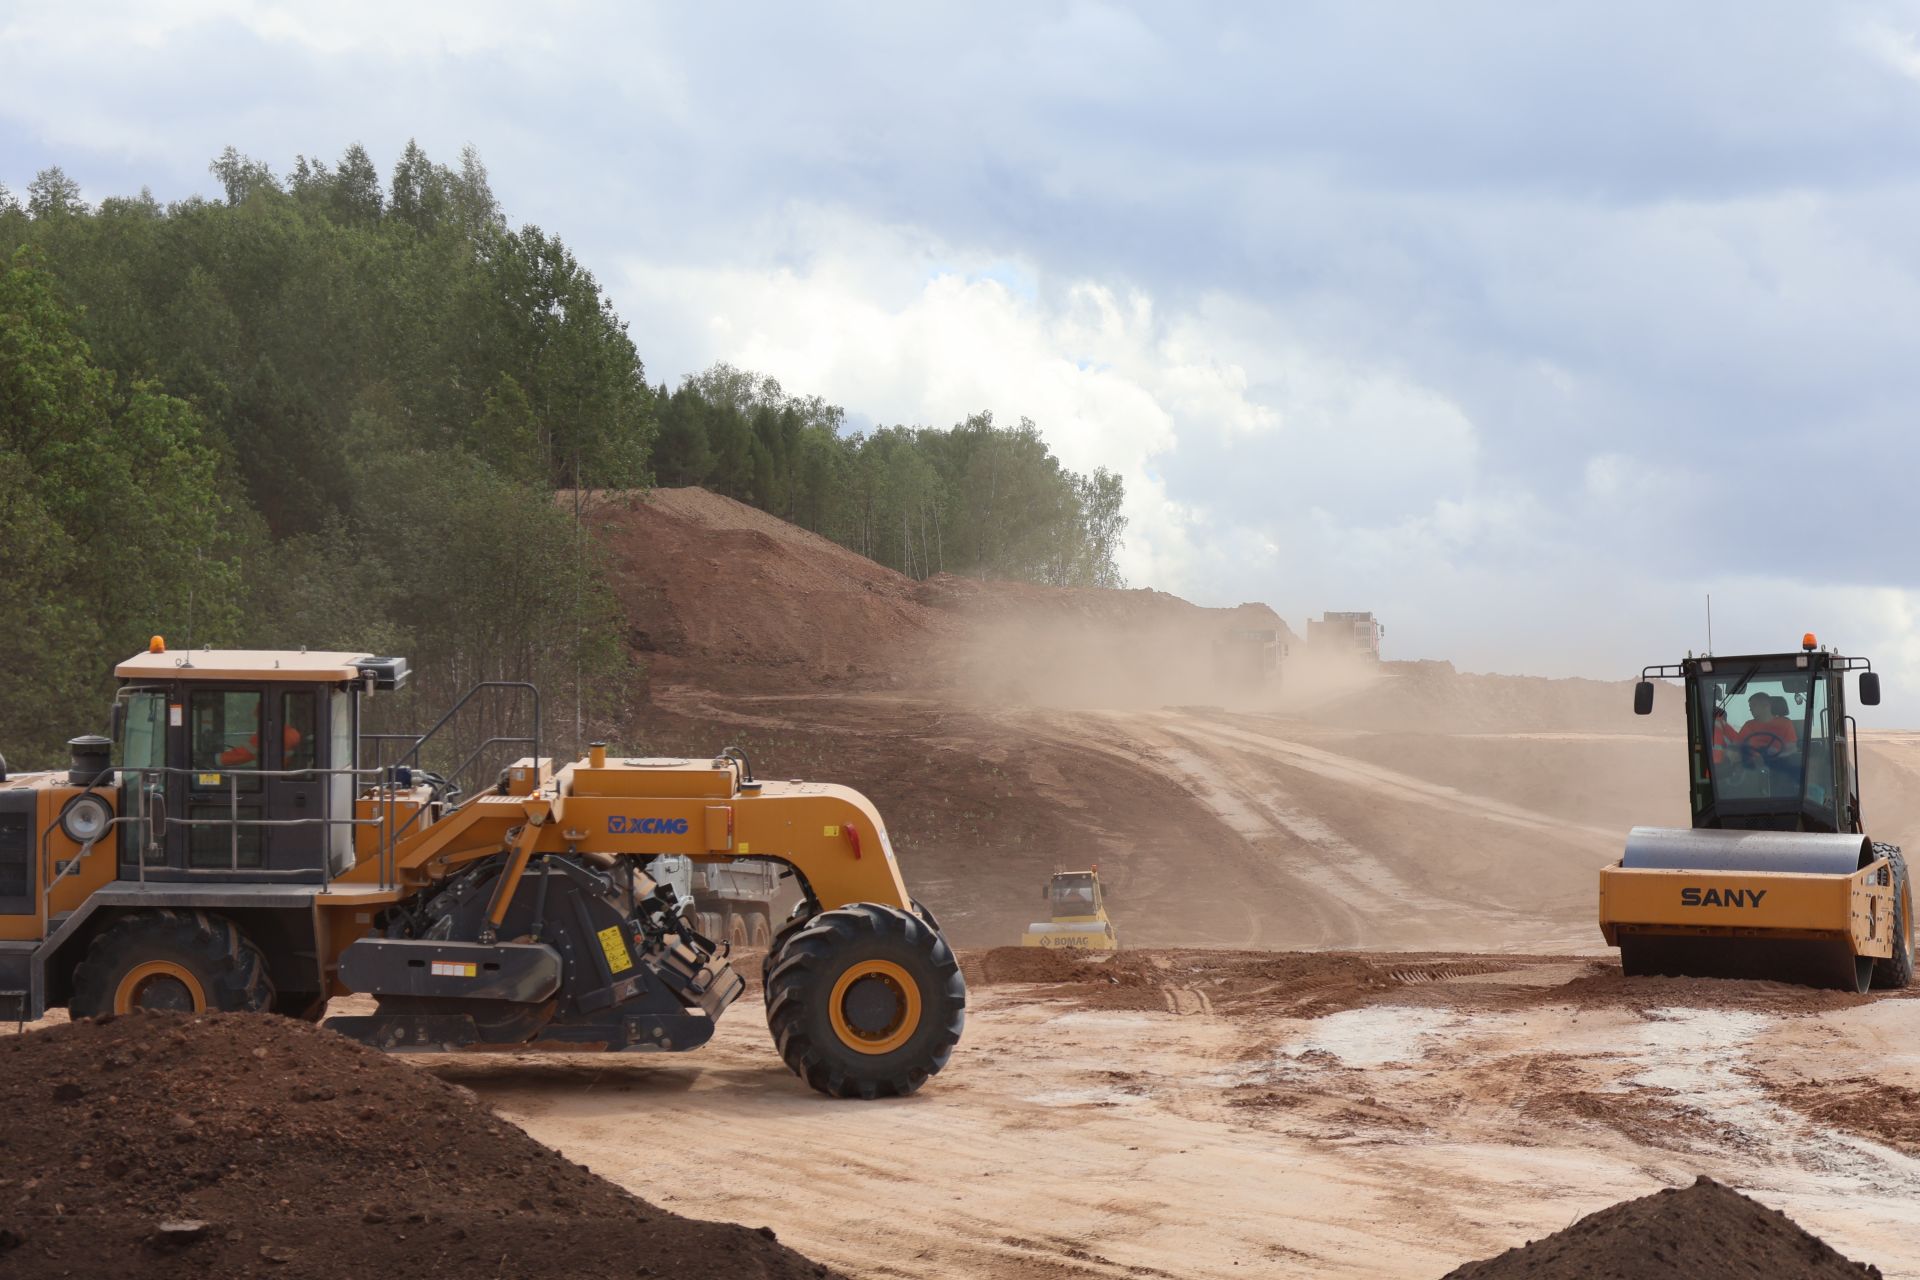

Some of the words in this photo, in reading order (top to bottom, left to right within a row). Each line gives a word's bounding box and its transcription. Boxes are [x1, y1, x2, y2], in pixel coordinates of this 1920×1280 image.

[629, 818, 688, 835] XCMG
[1681, 887, 1767, 908] SANY
[1054, 937, 1089, 946] BOMAG
